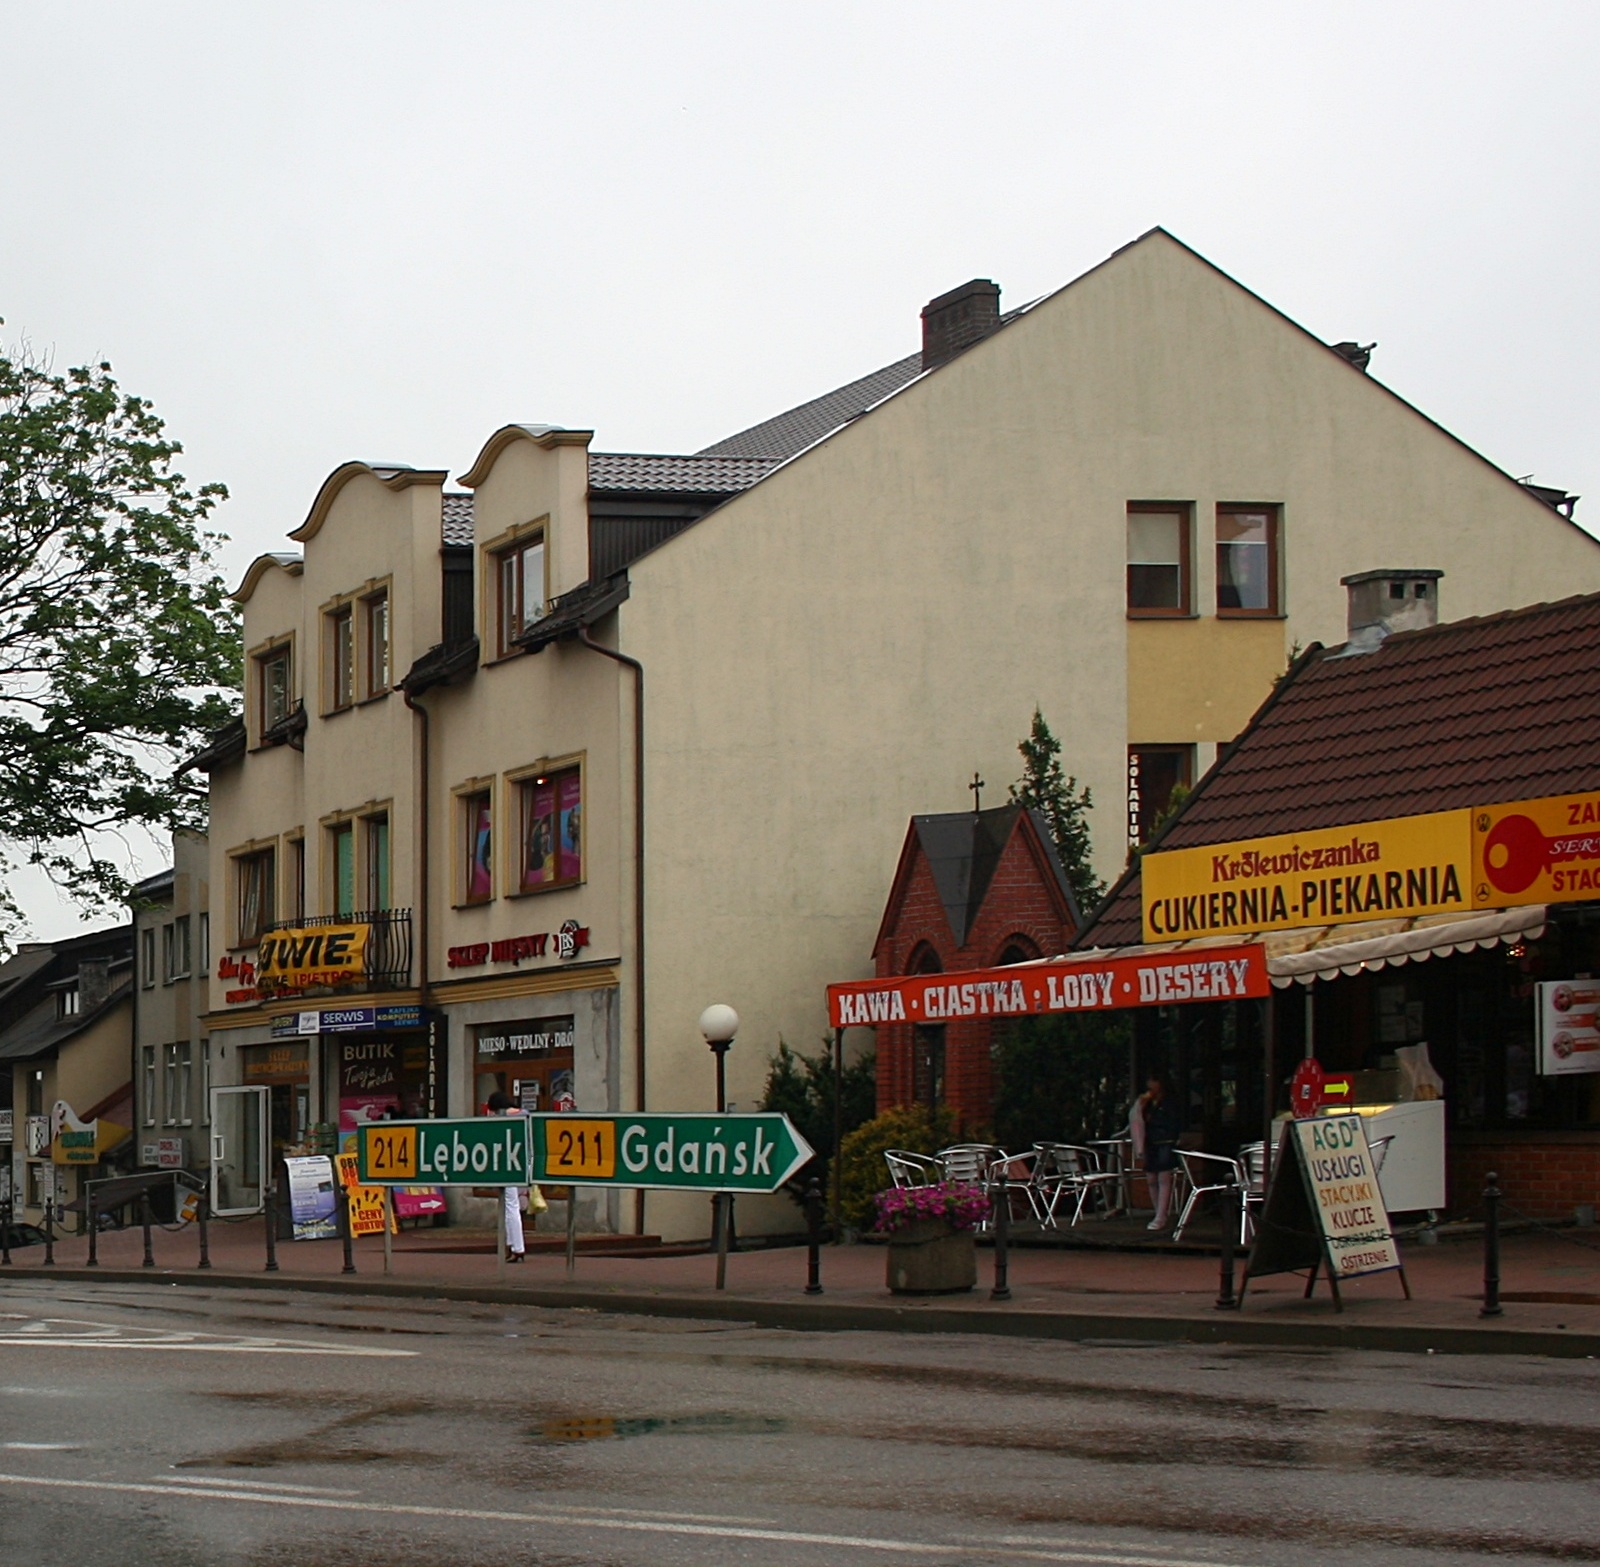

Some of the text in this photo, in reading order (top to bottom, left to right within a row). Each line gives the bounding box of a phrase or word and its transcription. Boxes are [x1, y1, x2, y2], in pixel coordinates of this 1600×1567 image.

[1128, 754, 1140, 847] SOLARIUM
[1568, 801, 1600, 826] ZA
[1549, 836, 1600, 855] SER
[1212, 837, 1380, 883] Królewiczanka
[1149, 863, 1462, 935] CUKIERNIA-PIEKARNIA
[447, 932, 549, 969] SKLEP MIĘSNY
[838, 958, 1249, 1024] KAWA CIASTKA LODY DESERY
[323, 1011, 364, 1024] SERWIS
[344, 1043, 394, 1060] BUTIK
[478, 1036, 506, 1056] MIĘSO
[508, 1032, 551, 1055] WĘDLINY
[344, 1064, 376, 1088] Twoja
[367, 1066, 394, 1089] moda
[1312, 1121, 1354, 1151] AGD
[373, 1134, 409, 1170] 214
[420, 1129, 523, 1181] Lębork
[558, 1124, 775, 1176] 211 Gdańsk
[1311, 1154, 1367, 1183] USŁUGI
[1319, 1182, 1374, 1208] STACYJKI
[353, 1219, 386, 1232] HURTOW
[358, 1209, 383, 1220] CENY
[1330, 1206, 1376, 1230] KLUCZE
